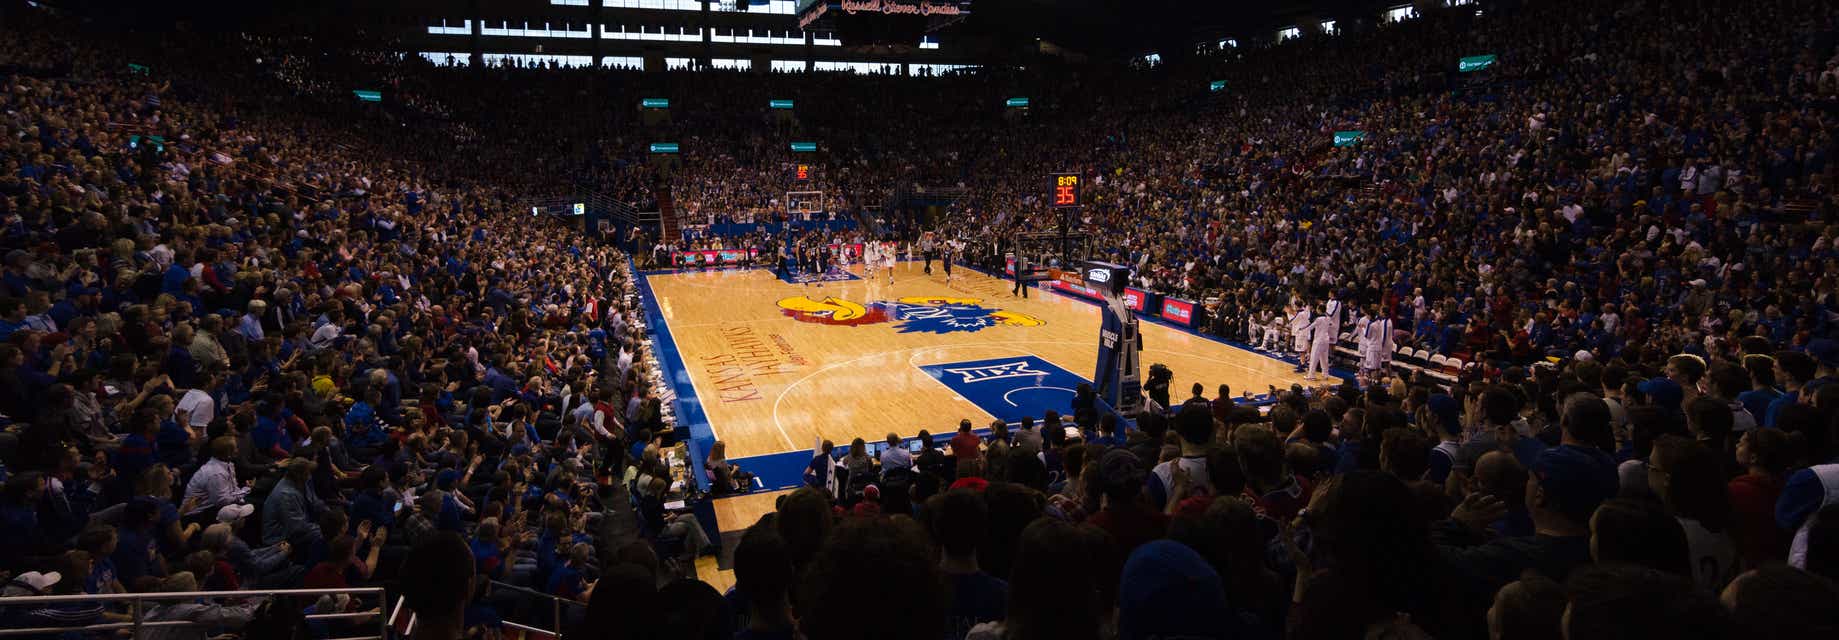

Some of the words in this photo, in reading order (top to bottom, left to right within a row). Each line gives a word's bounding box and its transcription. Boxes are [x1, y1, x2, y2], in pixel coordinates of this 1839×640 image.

[920, 0, 960, 16] Candies
[1058, 176, 1077, 186] 8:09
[1056, 186, 1075, 204] 35
[700, 353, 763, 403] KANSAS
